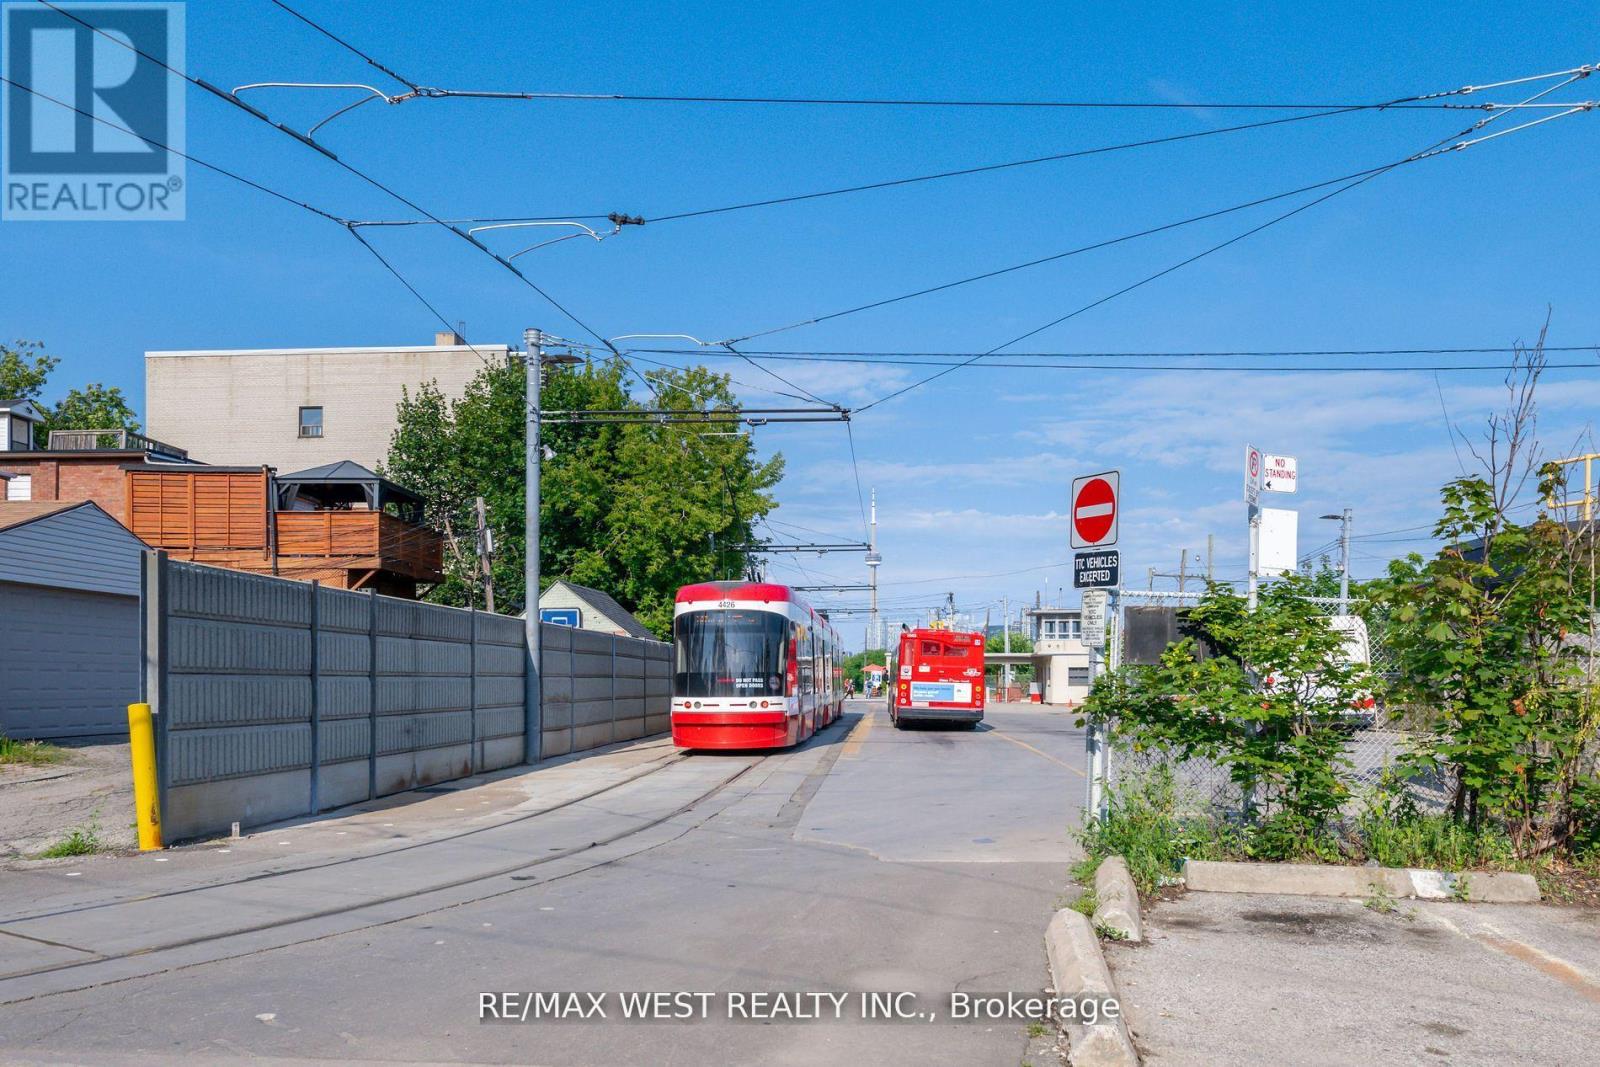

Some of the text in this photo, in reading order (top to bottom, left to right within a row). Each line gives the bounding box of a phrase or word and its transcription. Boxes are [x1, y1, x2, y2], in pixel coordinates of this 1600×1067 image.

[1275, 458, 1285, 468] NO
[1264, 468, 1296, 480] STANDING
[1075, 555, 1118, 570] TTC VEHICLES
